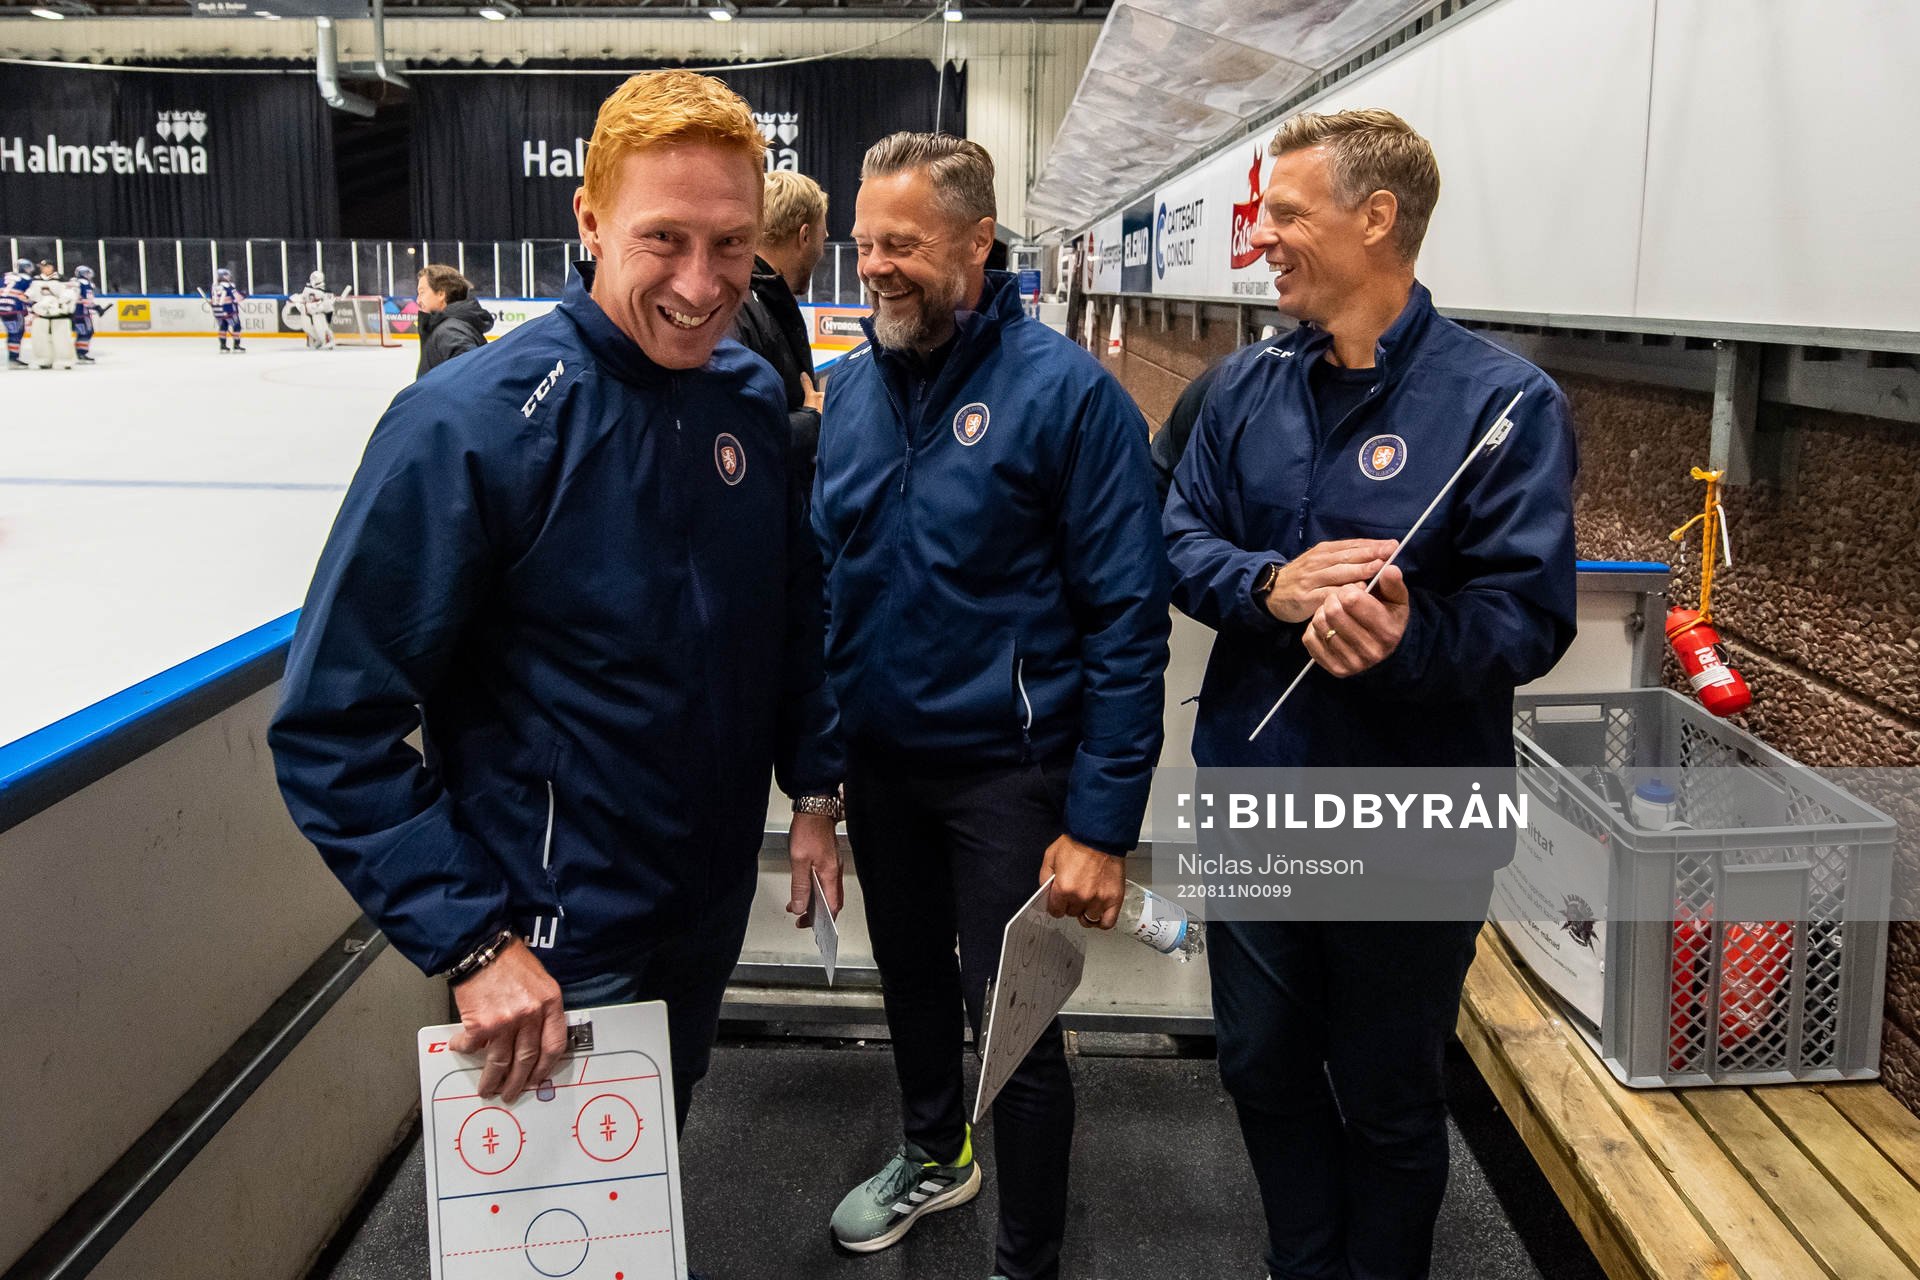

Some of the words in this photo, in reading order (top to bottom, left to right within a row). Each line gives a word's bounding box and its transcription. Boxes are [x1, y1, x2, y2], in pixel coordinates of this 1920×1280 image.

[1167, 199, 1204, 235] CATTEGATT
[1167, 238, 1195, 267] CONSULT
[521, 360, 565, 417] CCM
